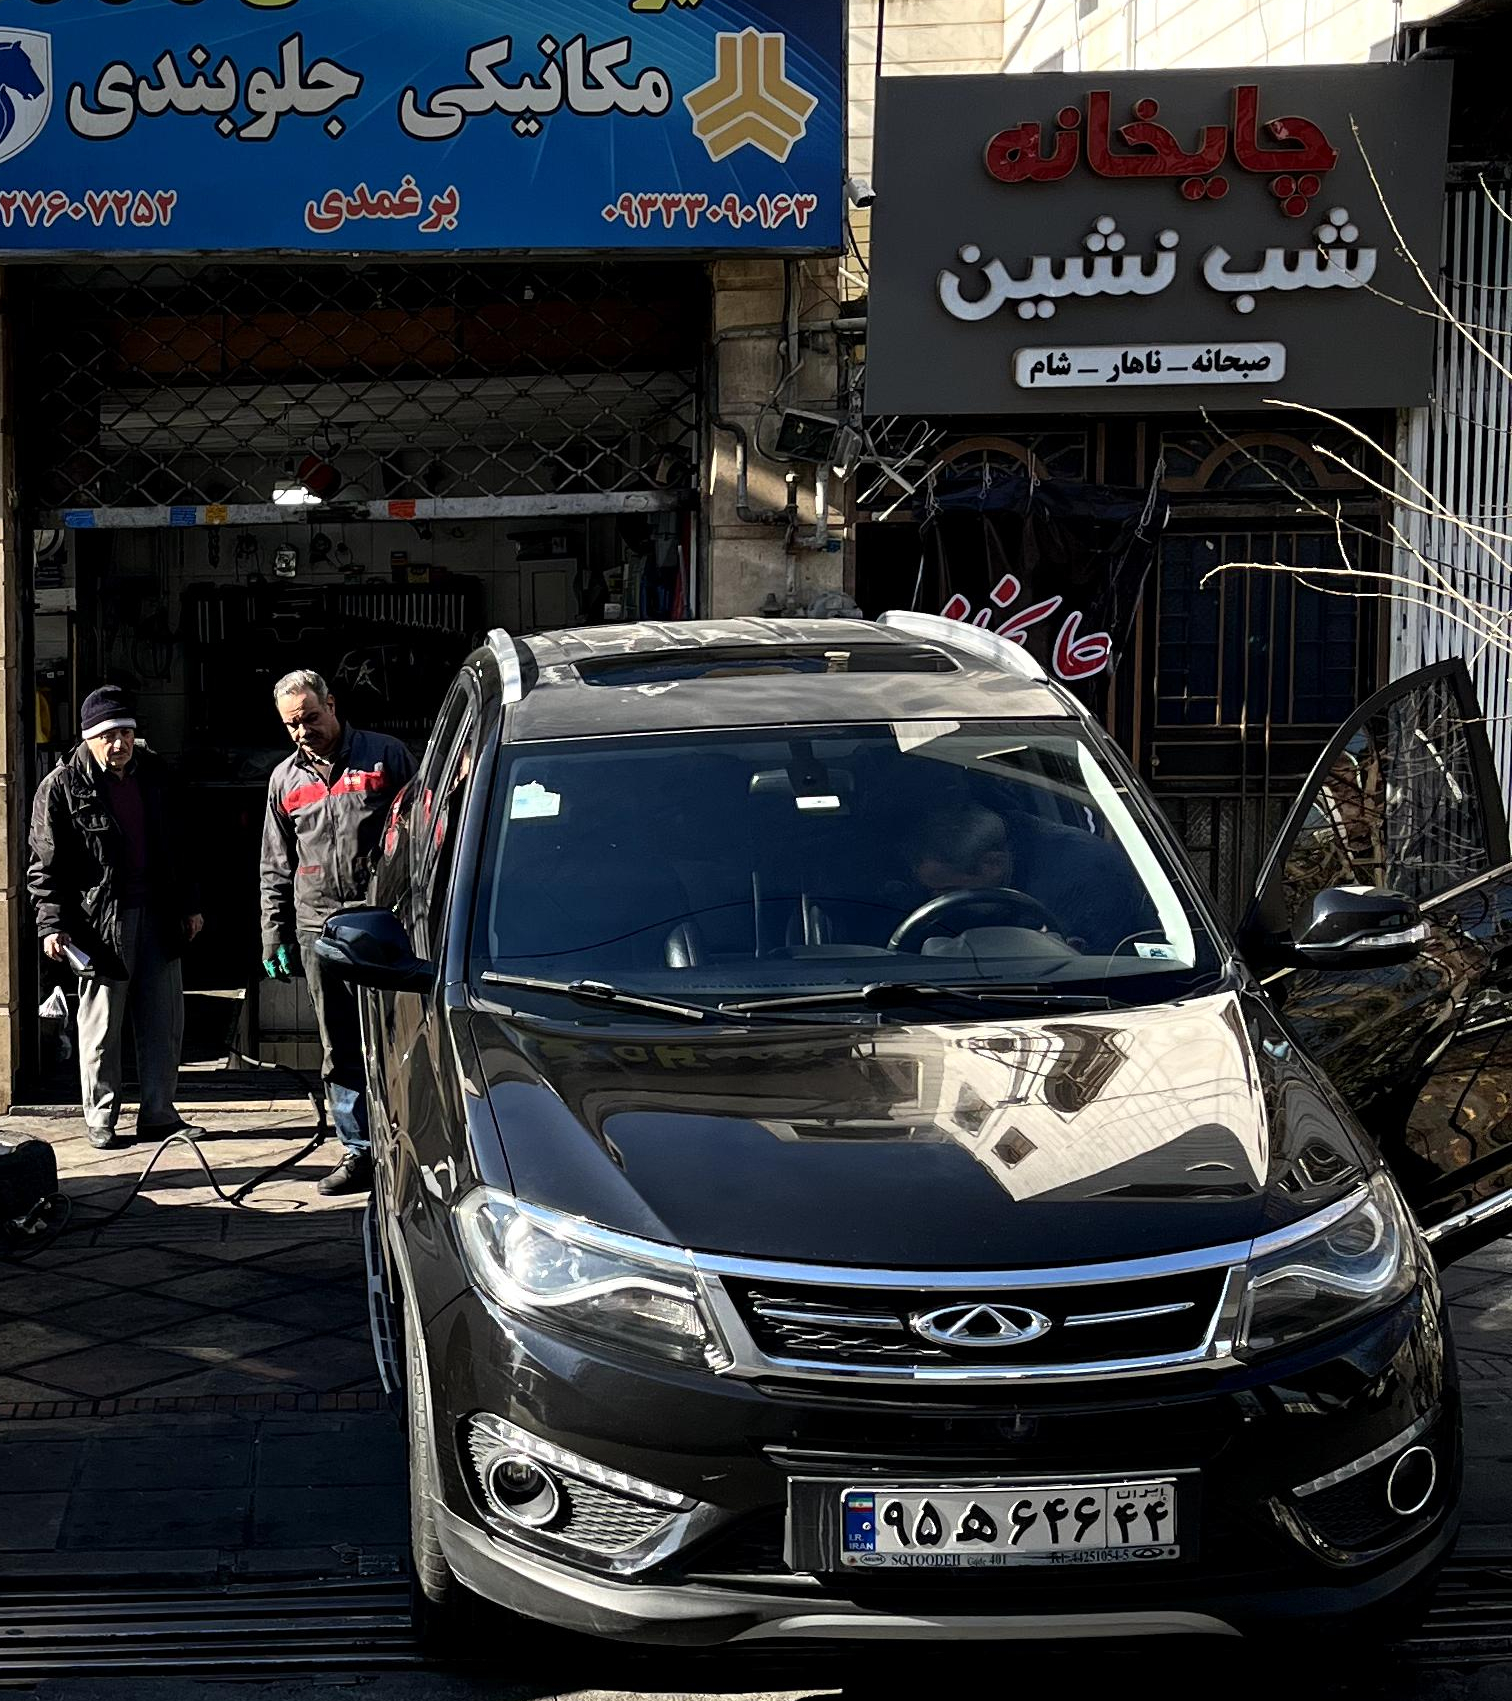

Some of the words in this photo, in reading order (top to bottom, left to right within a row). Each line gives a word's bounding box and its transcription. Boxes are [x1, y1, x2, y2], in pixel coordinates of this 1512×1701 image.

[67, 34, 364, 142] جلوبندی
[398, 24, 673, 142] مکانیکی
[984, 84, 1341, 217] چایخانه
[303, 174, 459, 234] برغمدی
[601, 193, 817, 229] ۰۹۳۳۳۰۹۰۱۶۳
[935, 214, 1180, 322] نشین
[1203, 206, 1378, 314] شب
[1030, 352, 1071, 383] شام
[1106, 350, 1162, 383] ناهار
[1116, 1487, 1164, 1499] ایران
[849, 1541, 873, 1550] IRAN
